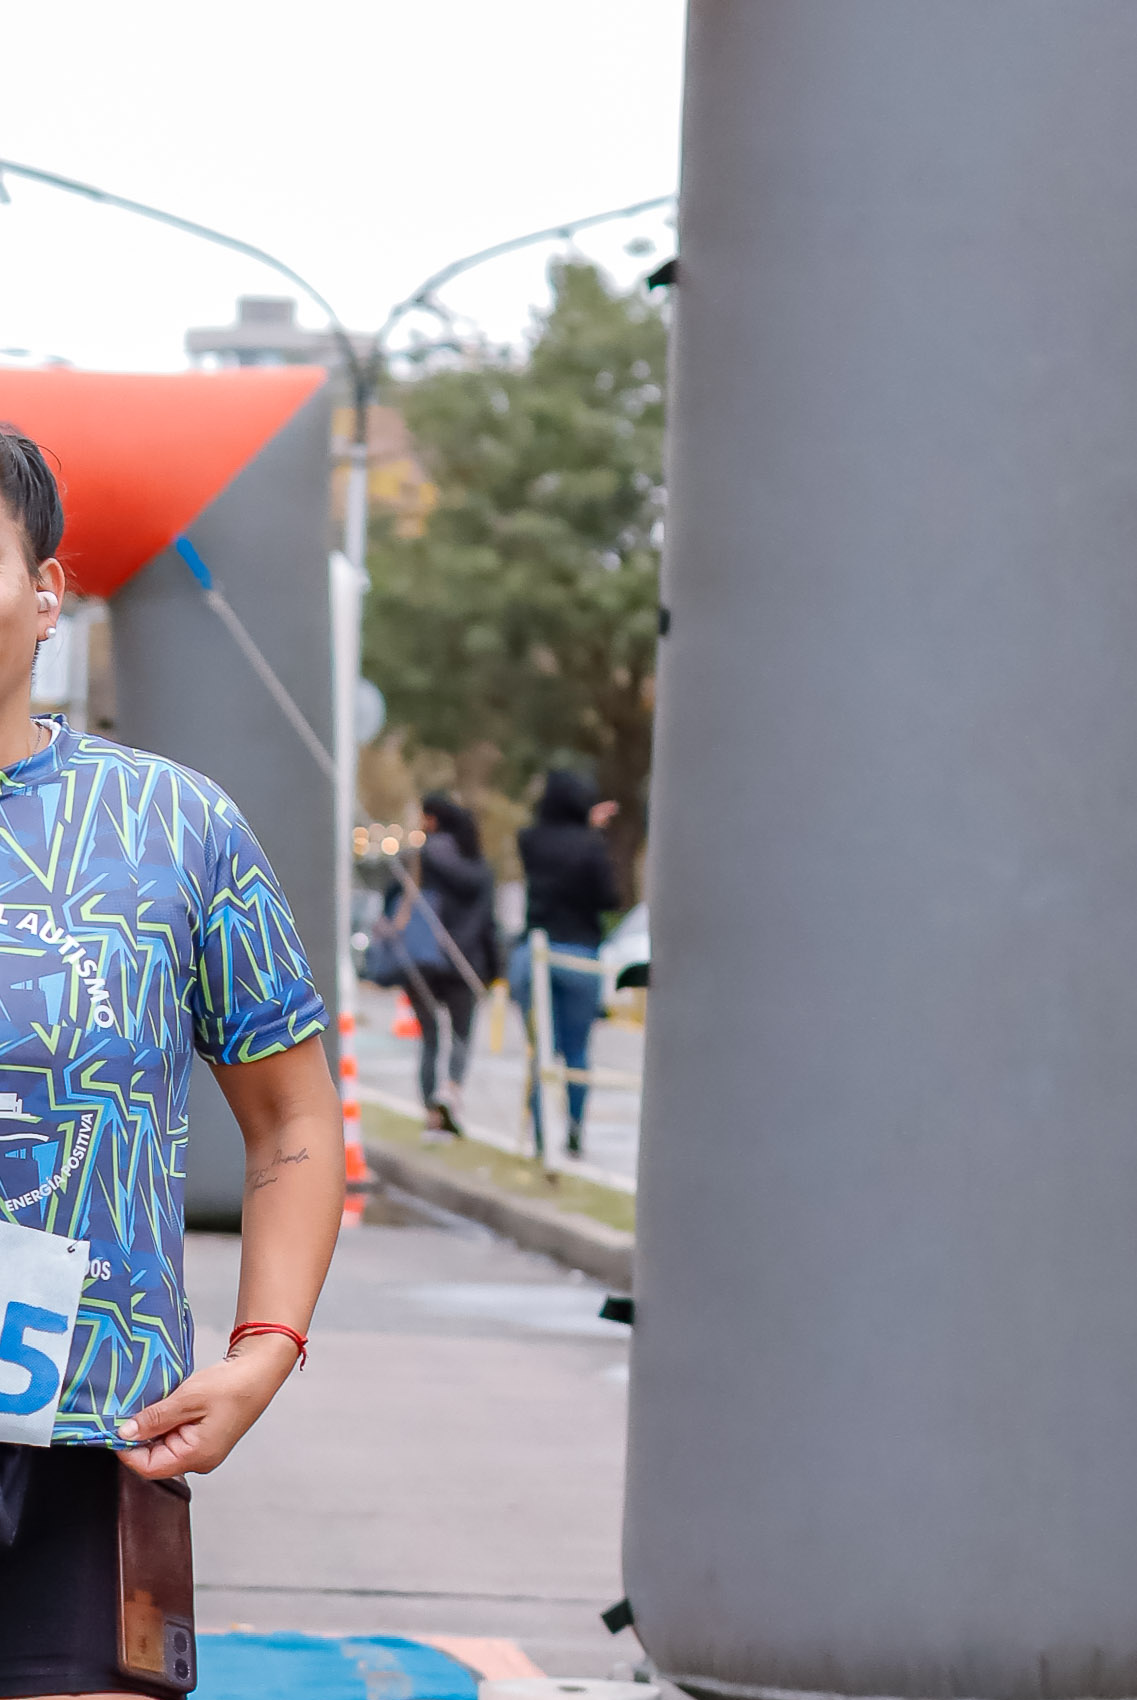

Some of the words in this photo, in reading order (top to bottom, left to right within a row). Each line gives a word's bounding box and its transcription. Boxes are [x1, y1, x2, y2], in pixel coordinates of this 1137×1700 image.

[15, 912, 114, 1029] AUTISMO
[4, 1174, 66, 1213] ENERGÍA
[60, 1112, 94, 1178] POSITIVA
